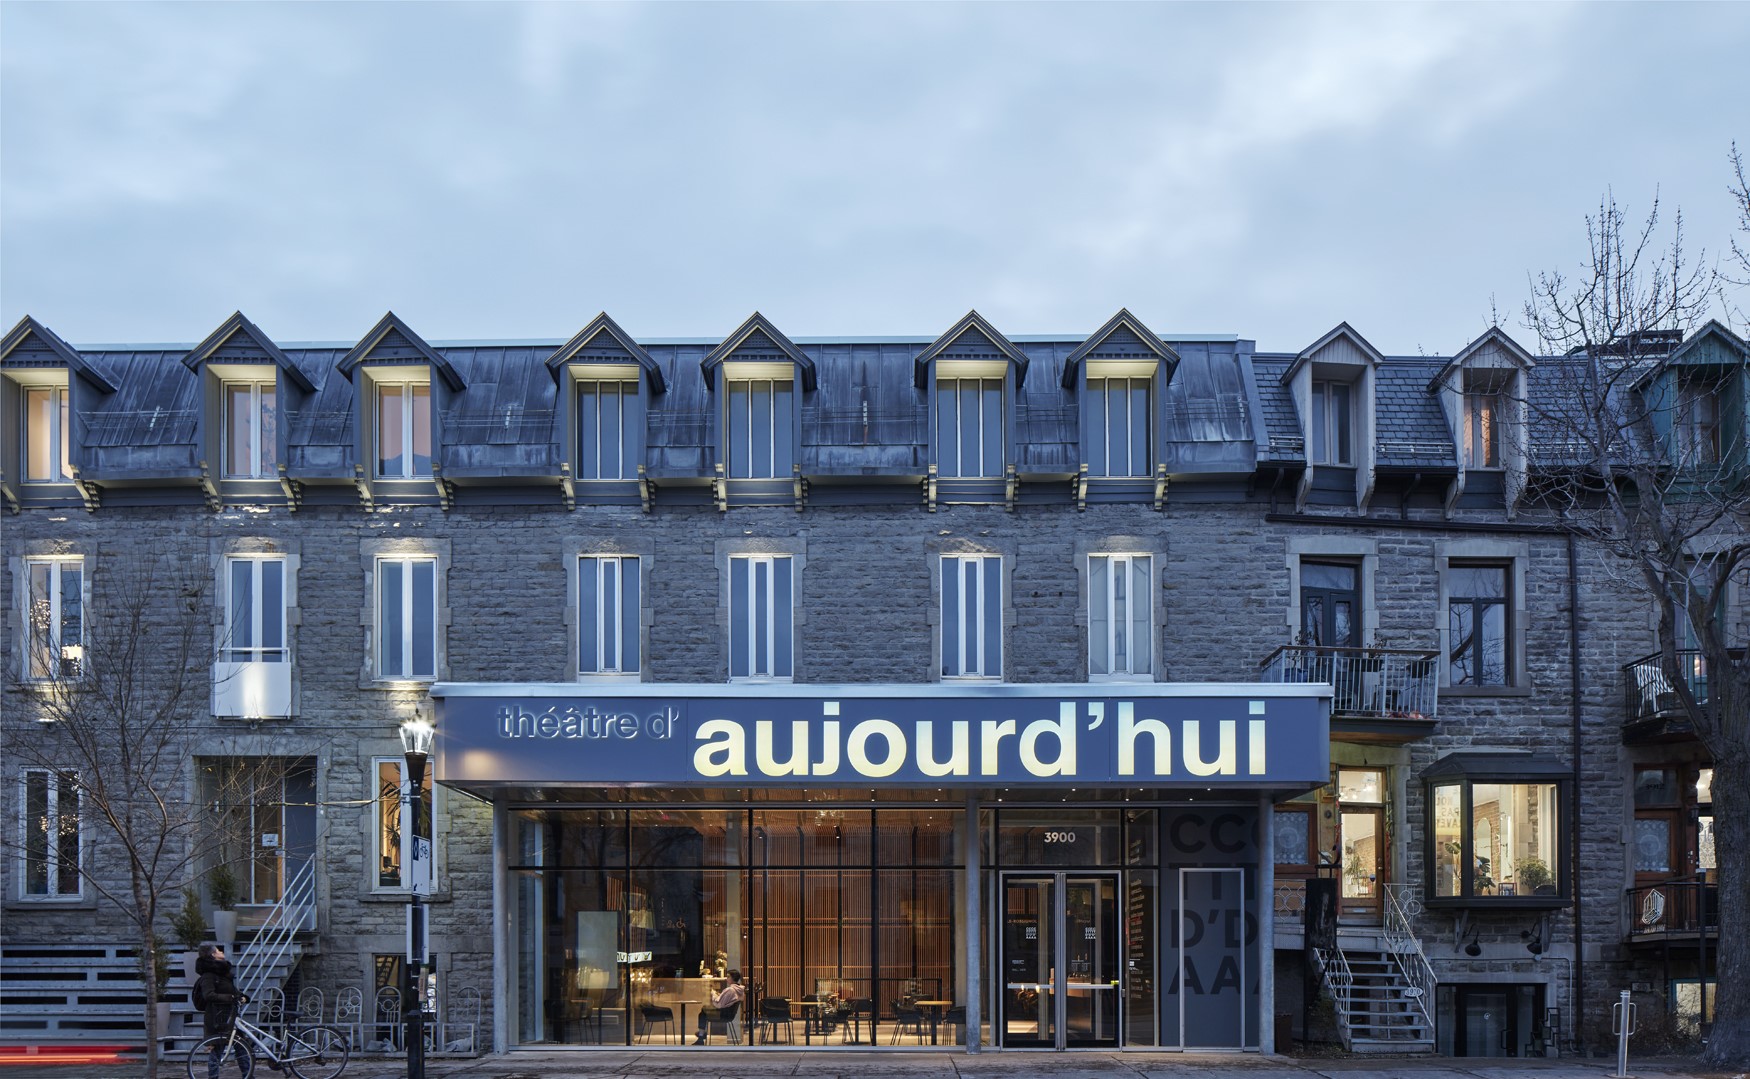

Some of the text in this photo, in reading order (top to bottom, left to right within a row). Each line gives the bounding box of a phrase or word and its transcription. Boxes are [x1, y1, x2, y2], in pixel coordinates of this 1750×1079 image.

[496, 705, 680, 739] théâtre d'
[693, 700, 1266, 777] aujourd'hui
[1044, 831, 1076, 844] 3900
[1170, 813, 1260, 854] CC
[1168, 955, 1260, 995] AA
